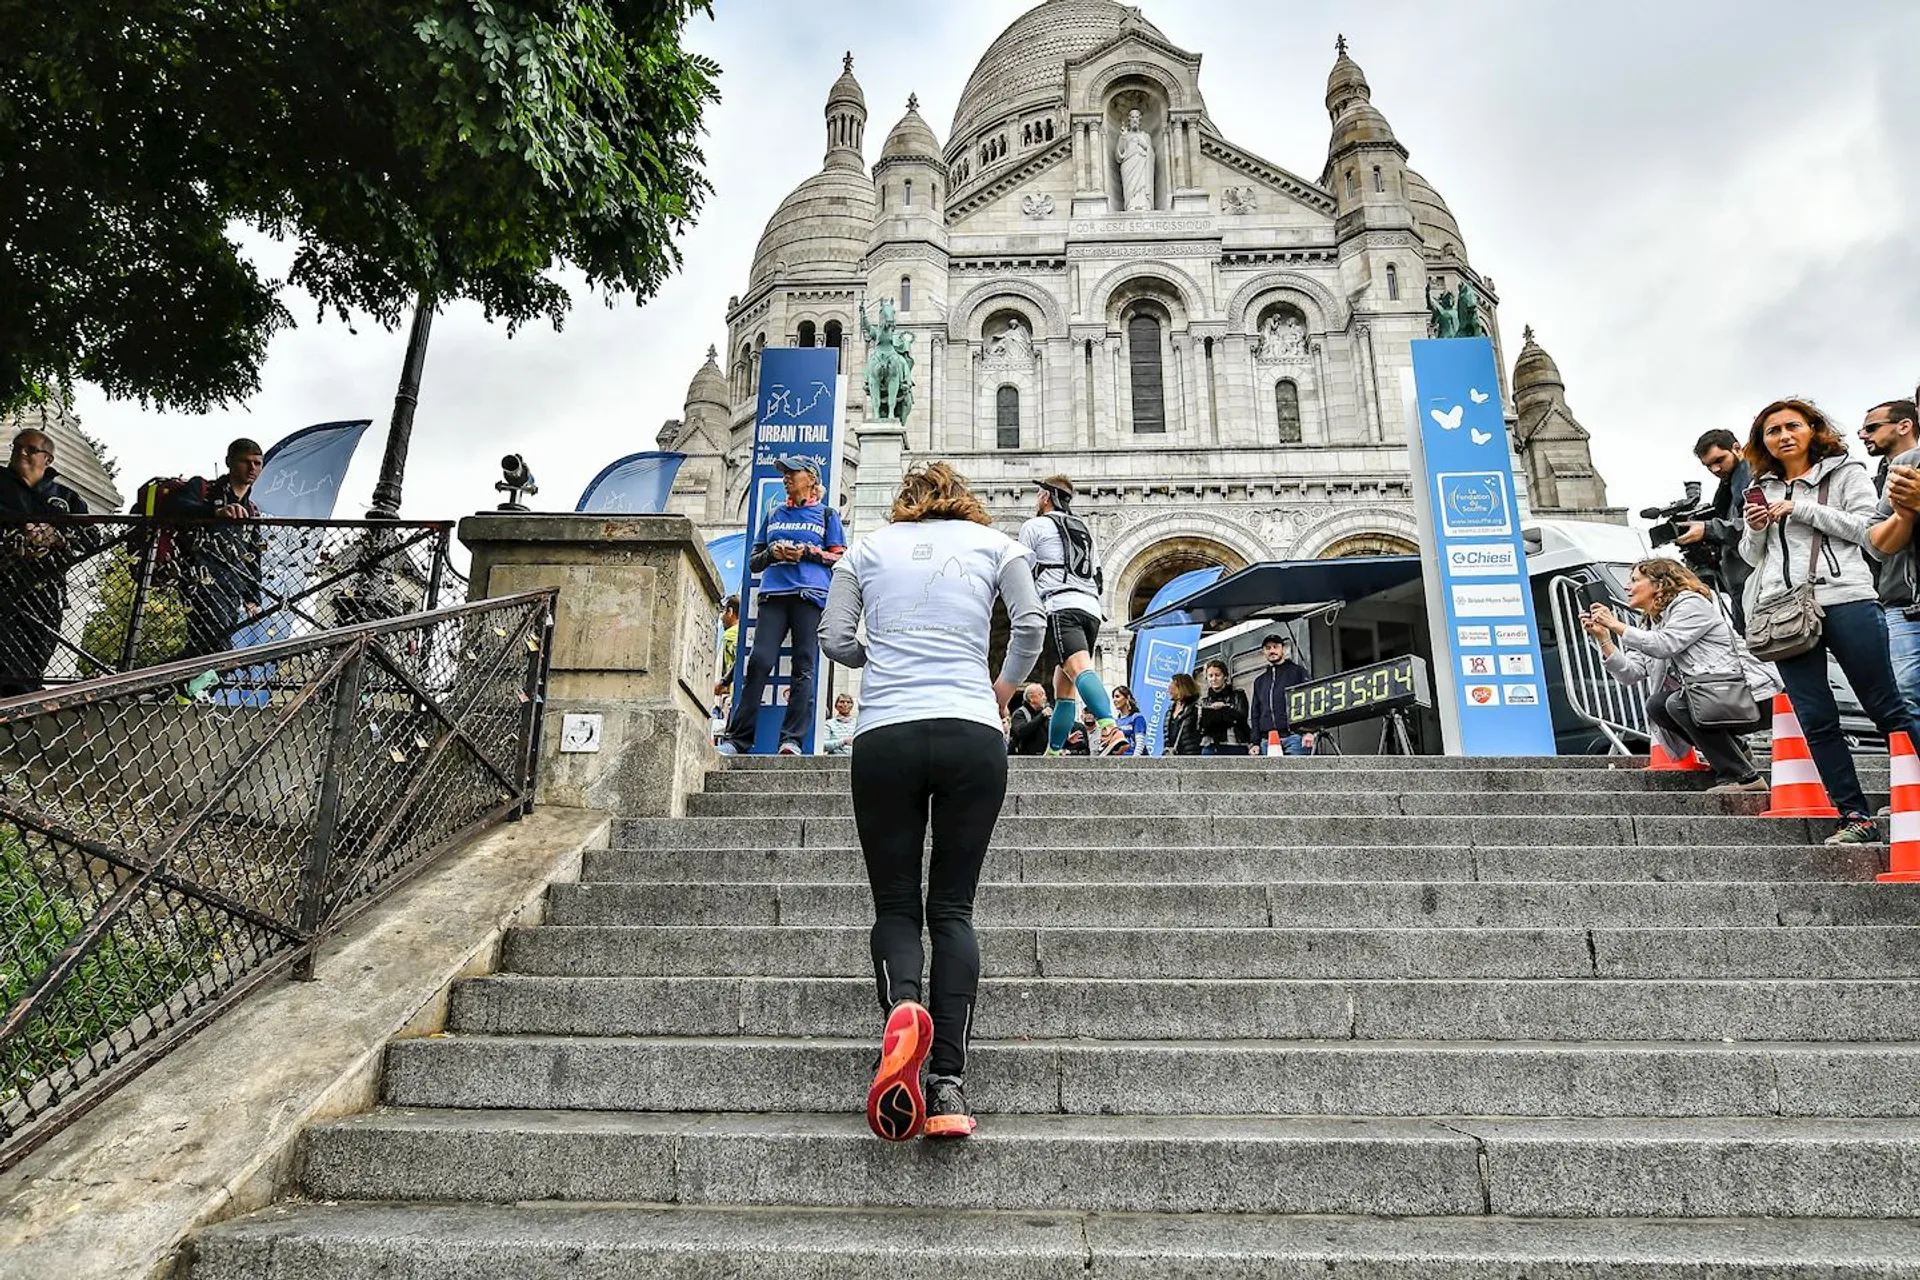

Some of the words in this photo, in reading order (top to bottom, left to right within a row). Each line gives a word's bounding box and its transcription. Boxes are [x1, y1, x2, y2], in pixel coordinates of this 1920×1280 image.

[758, 425, 796, 442] URBAN
[798, 425, 829, 442] TRAIL
[1467, 550, 1512, 564] Chiesi
[1290, 664, 1412, 721] 00:35:04
[1146, 690, 1167, 756] ouffle.org
